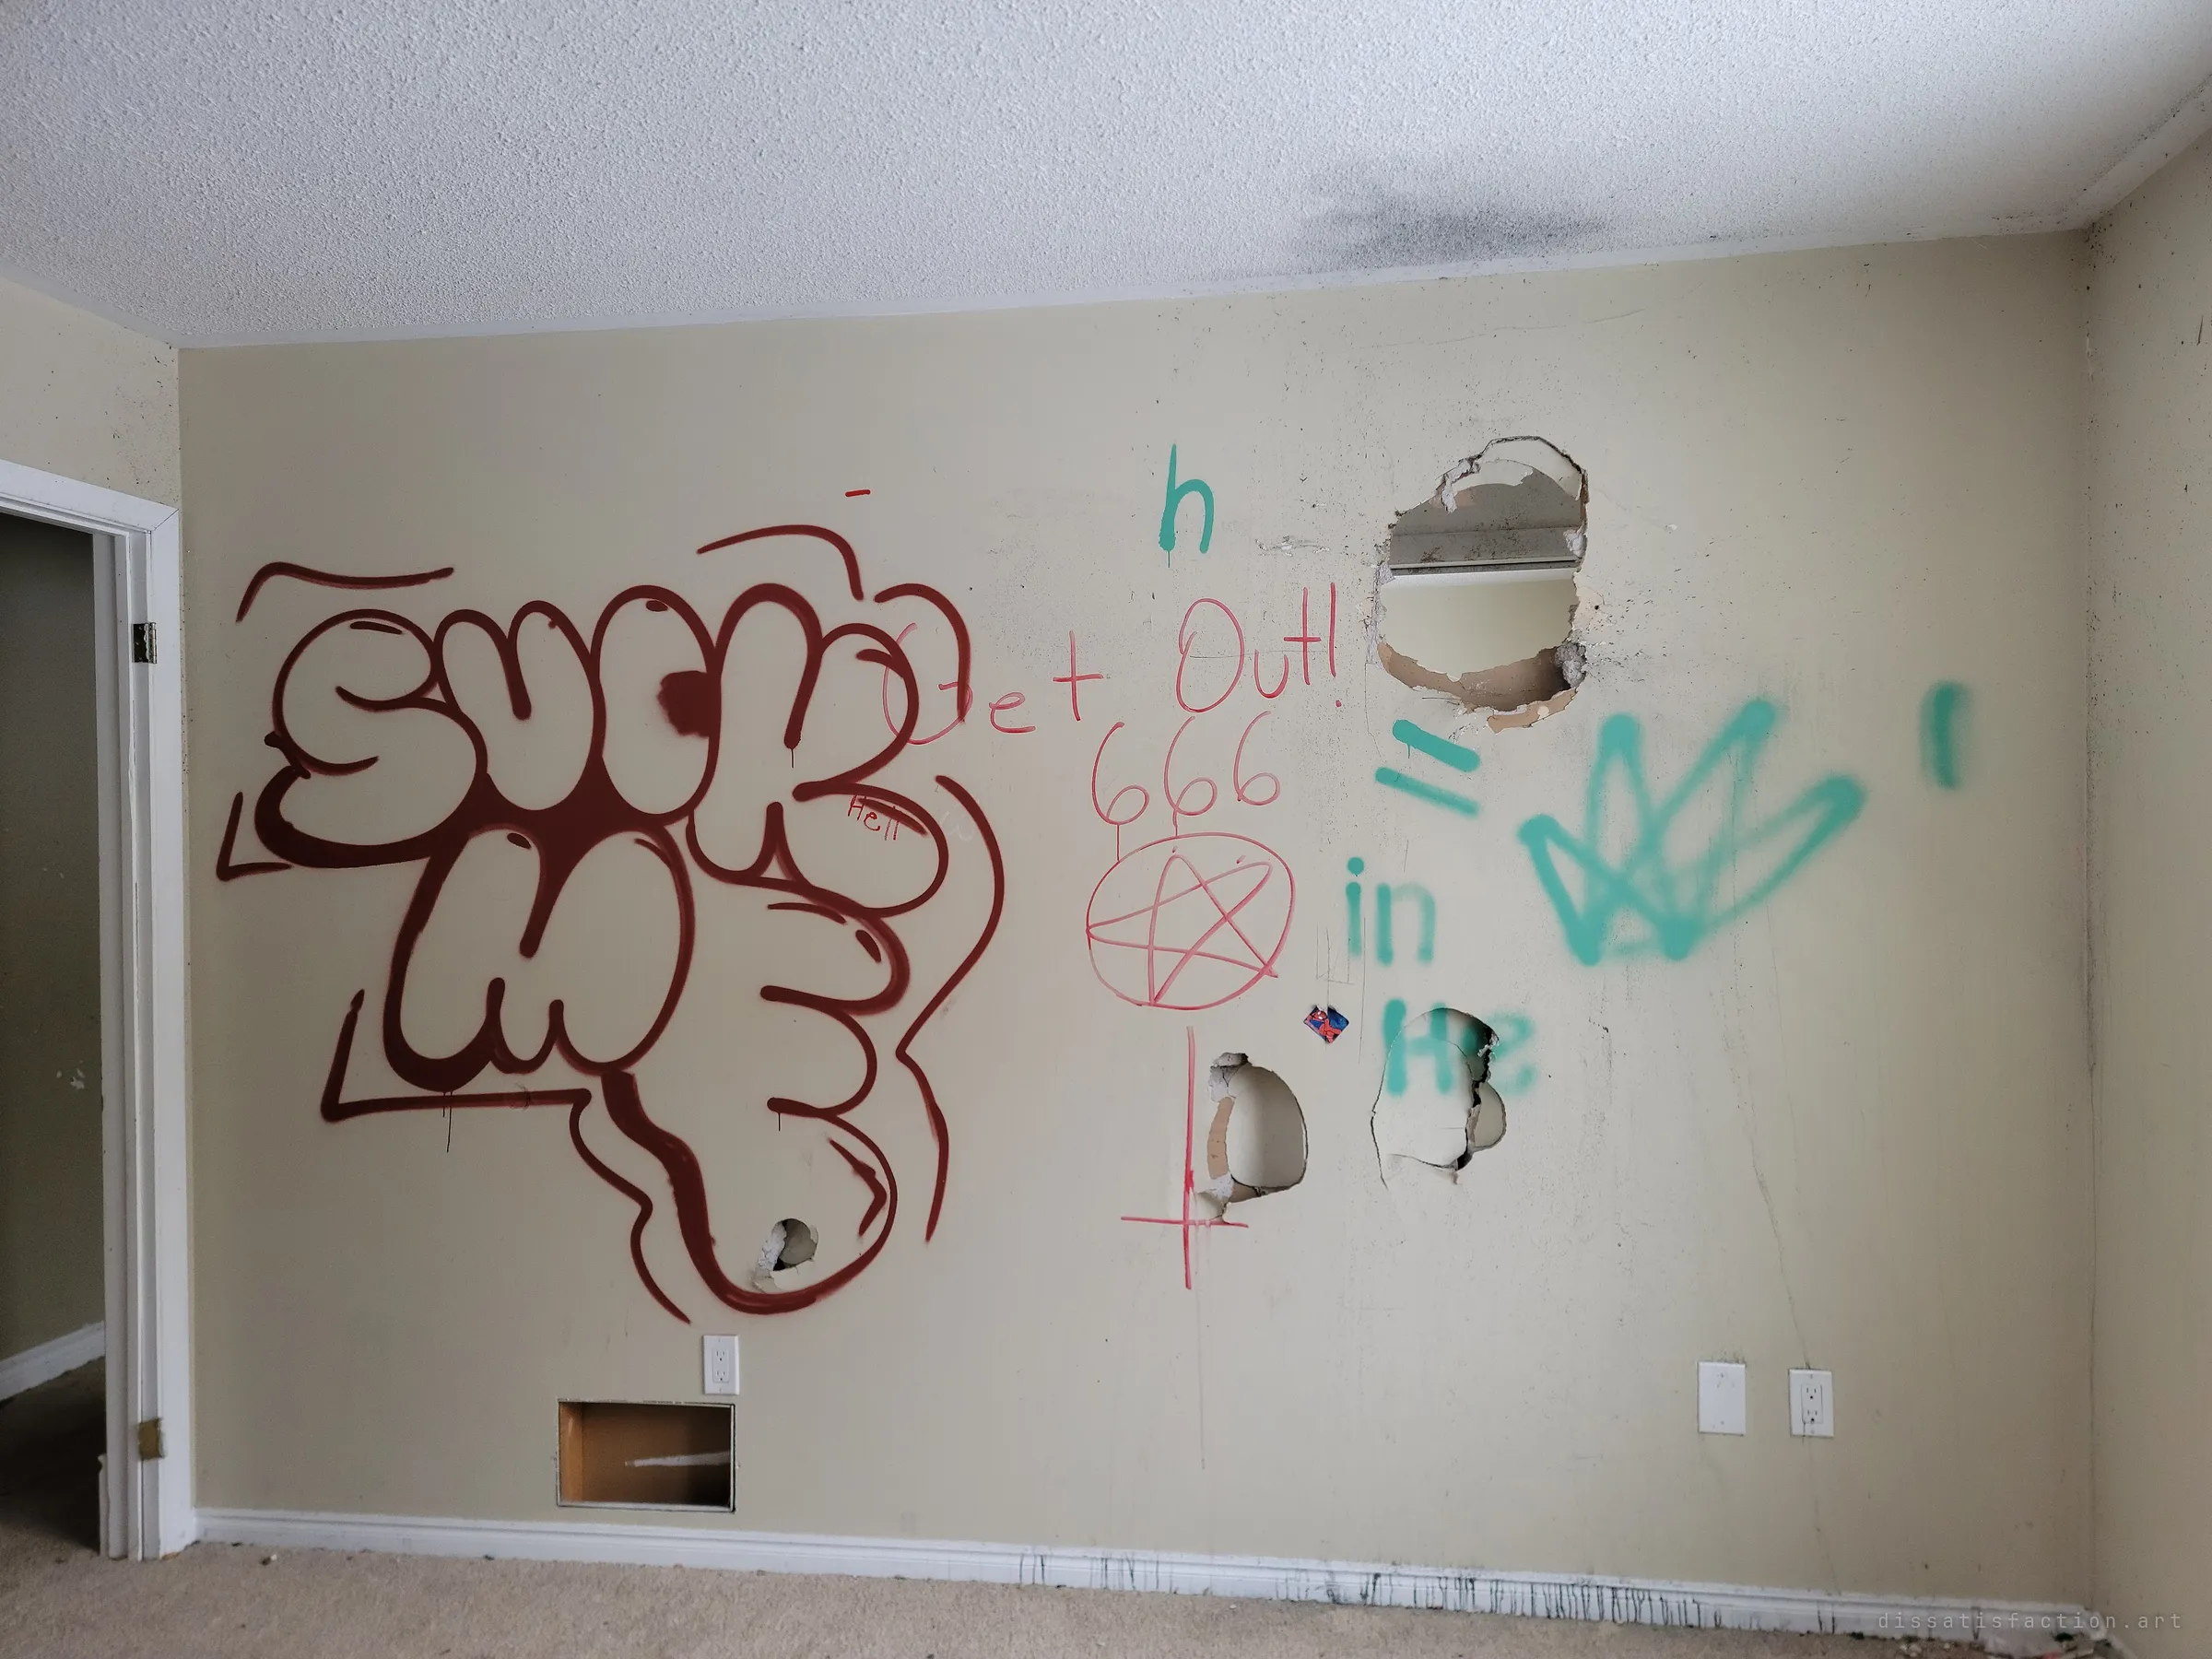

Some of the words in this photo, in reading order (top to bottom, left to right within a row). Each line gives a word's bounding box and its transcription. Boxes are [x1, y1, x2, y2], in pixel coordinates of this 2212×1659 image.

[882, 621, 1106, 746] Get
[1176, 582, 1345, 713] Out!
[1091, 711, 1281, 827] 666
[1345, 857, 1437, 967] in
